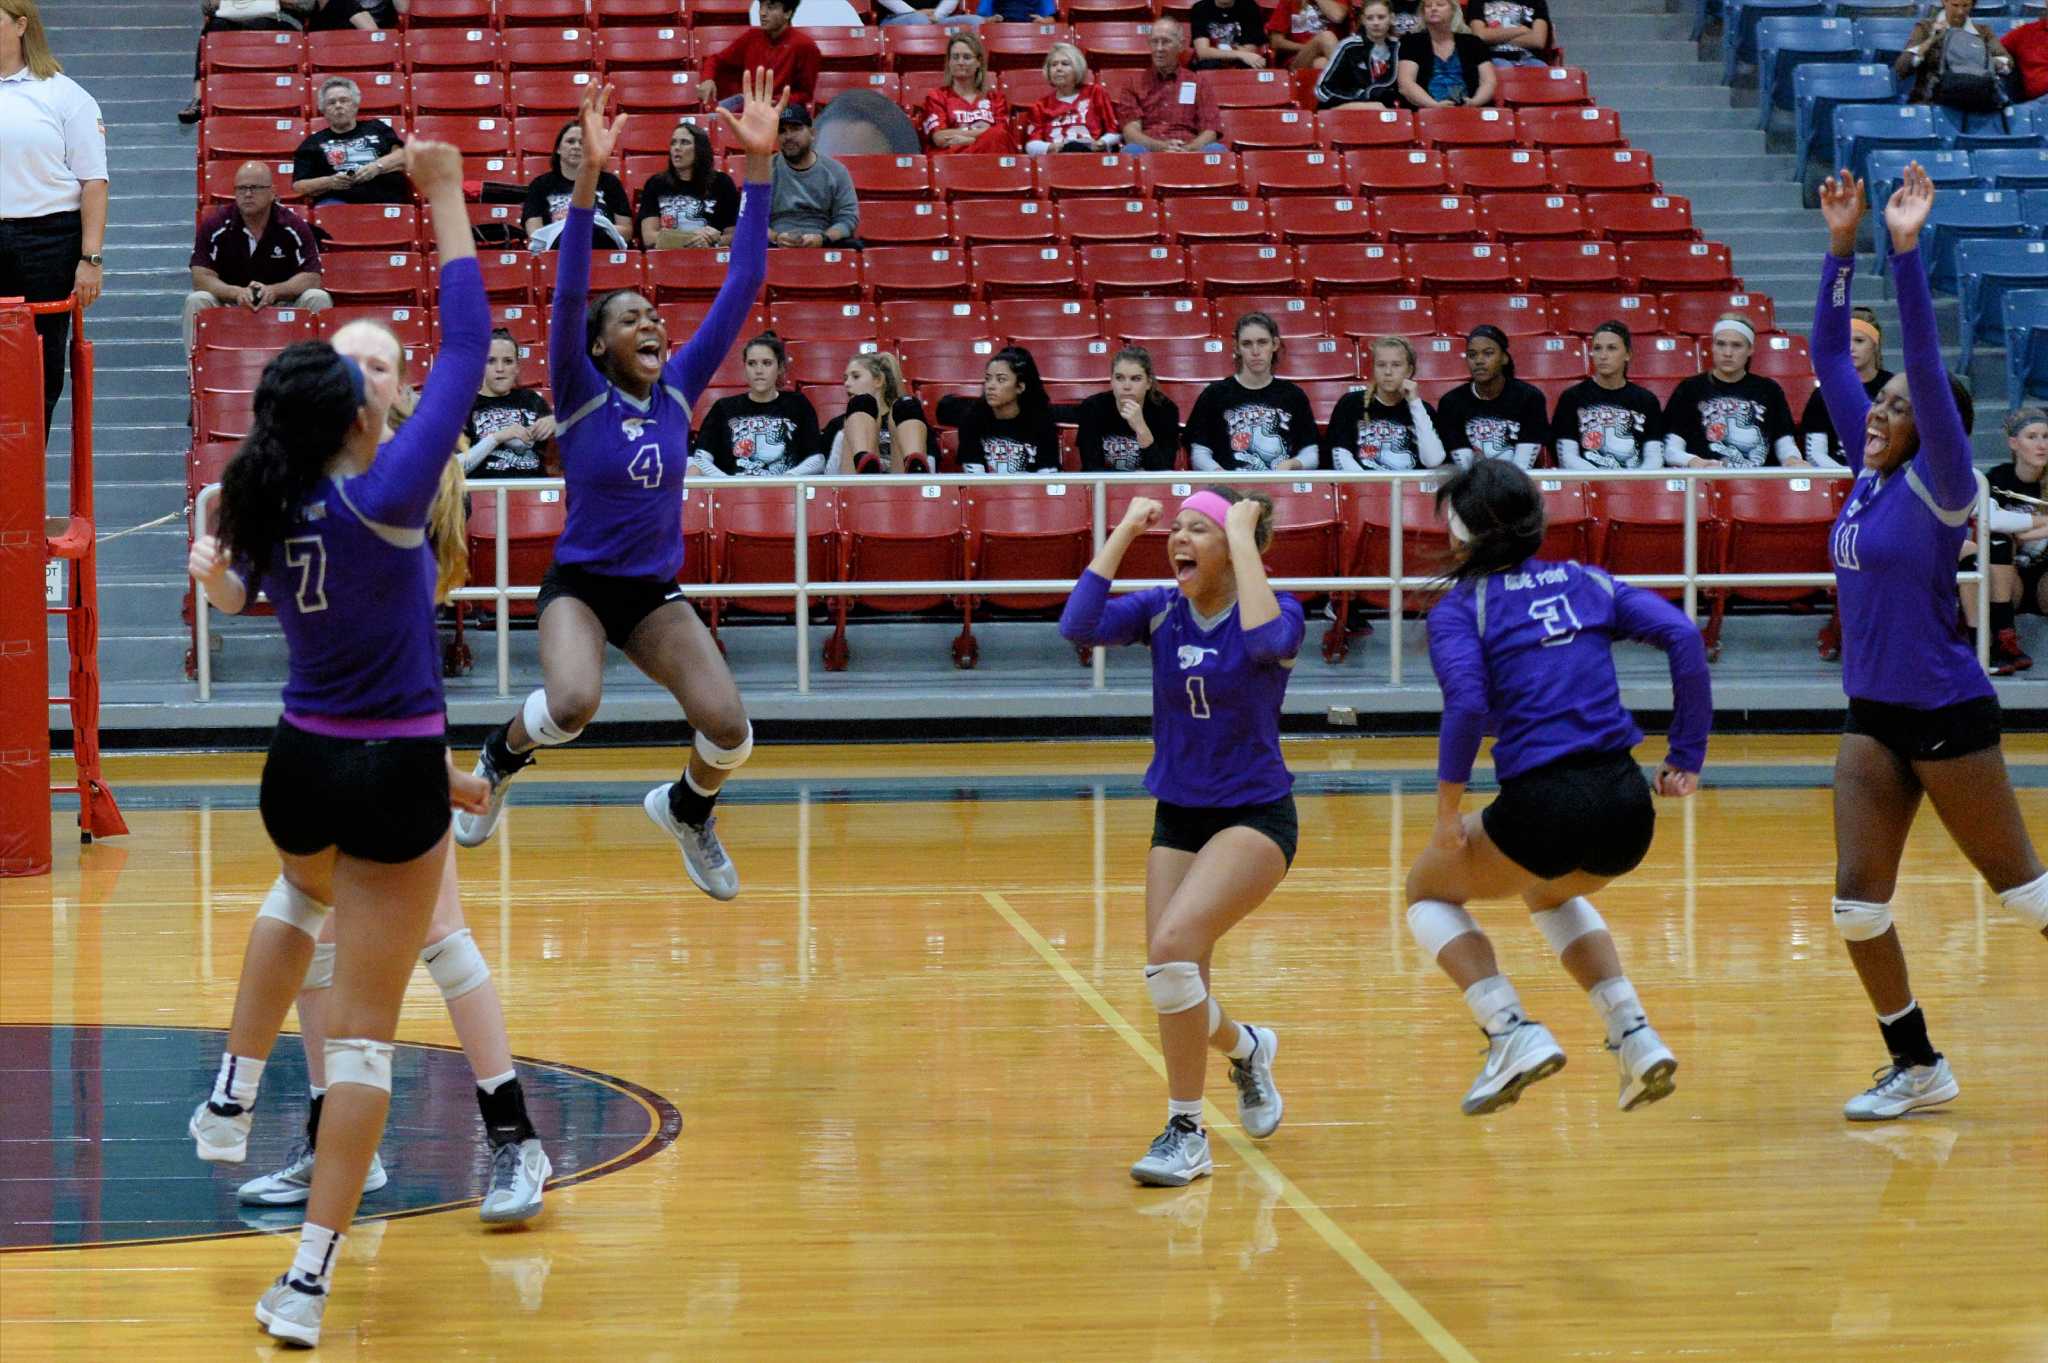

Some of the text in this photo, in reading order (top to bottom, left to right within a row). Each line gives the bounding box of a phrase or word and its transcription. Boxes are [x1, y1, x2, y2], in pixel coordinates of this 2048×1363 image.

[627, 443, 663, 488] 4
[1834, 521, 1860, 571] 11
[285, 534, 328, 614] 7
[1528, 593, 1584, 648] 2
[1186, 676, 1211, 719] 1
